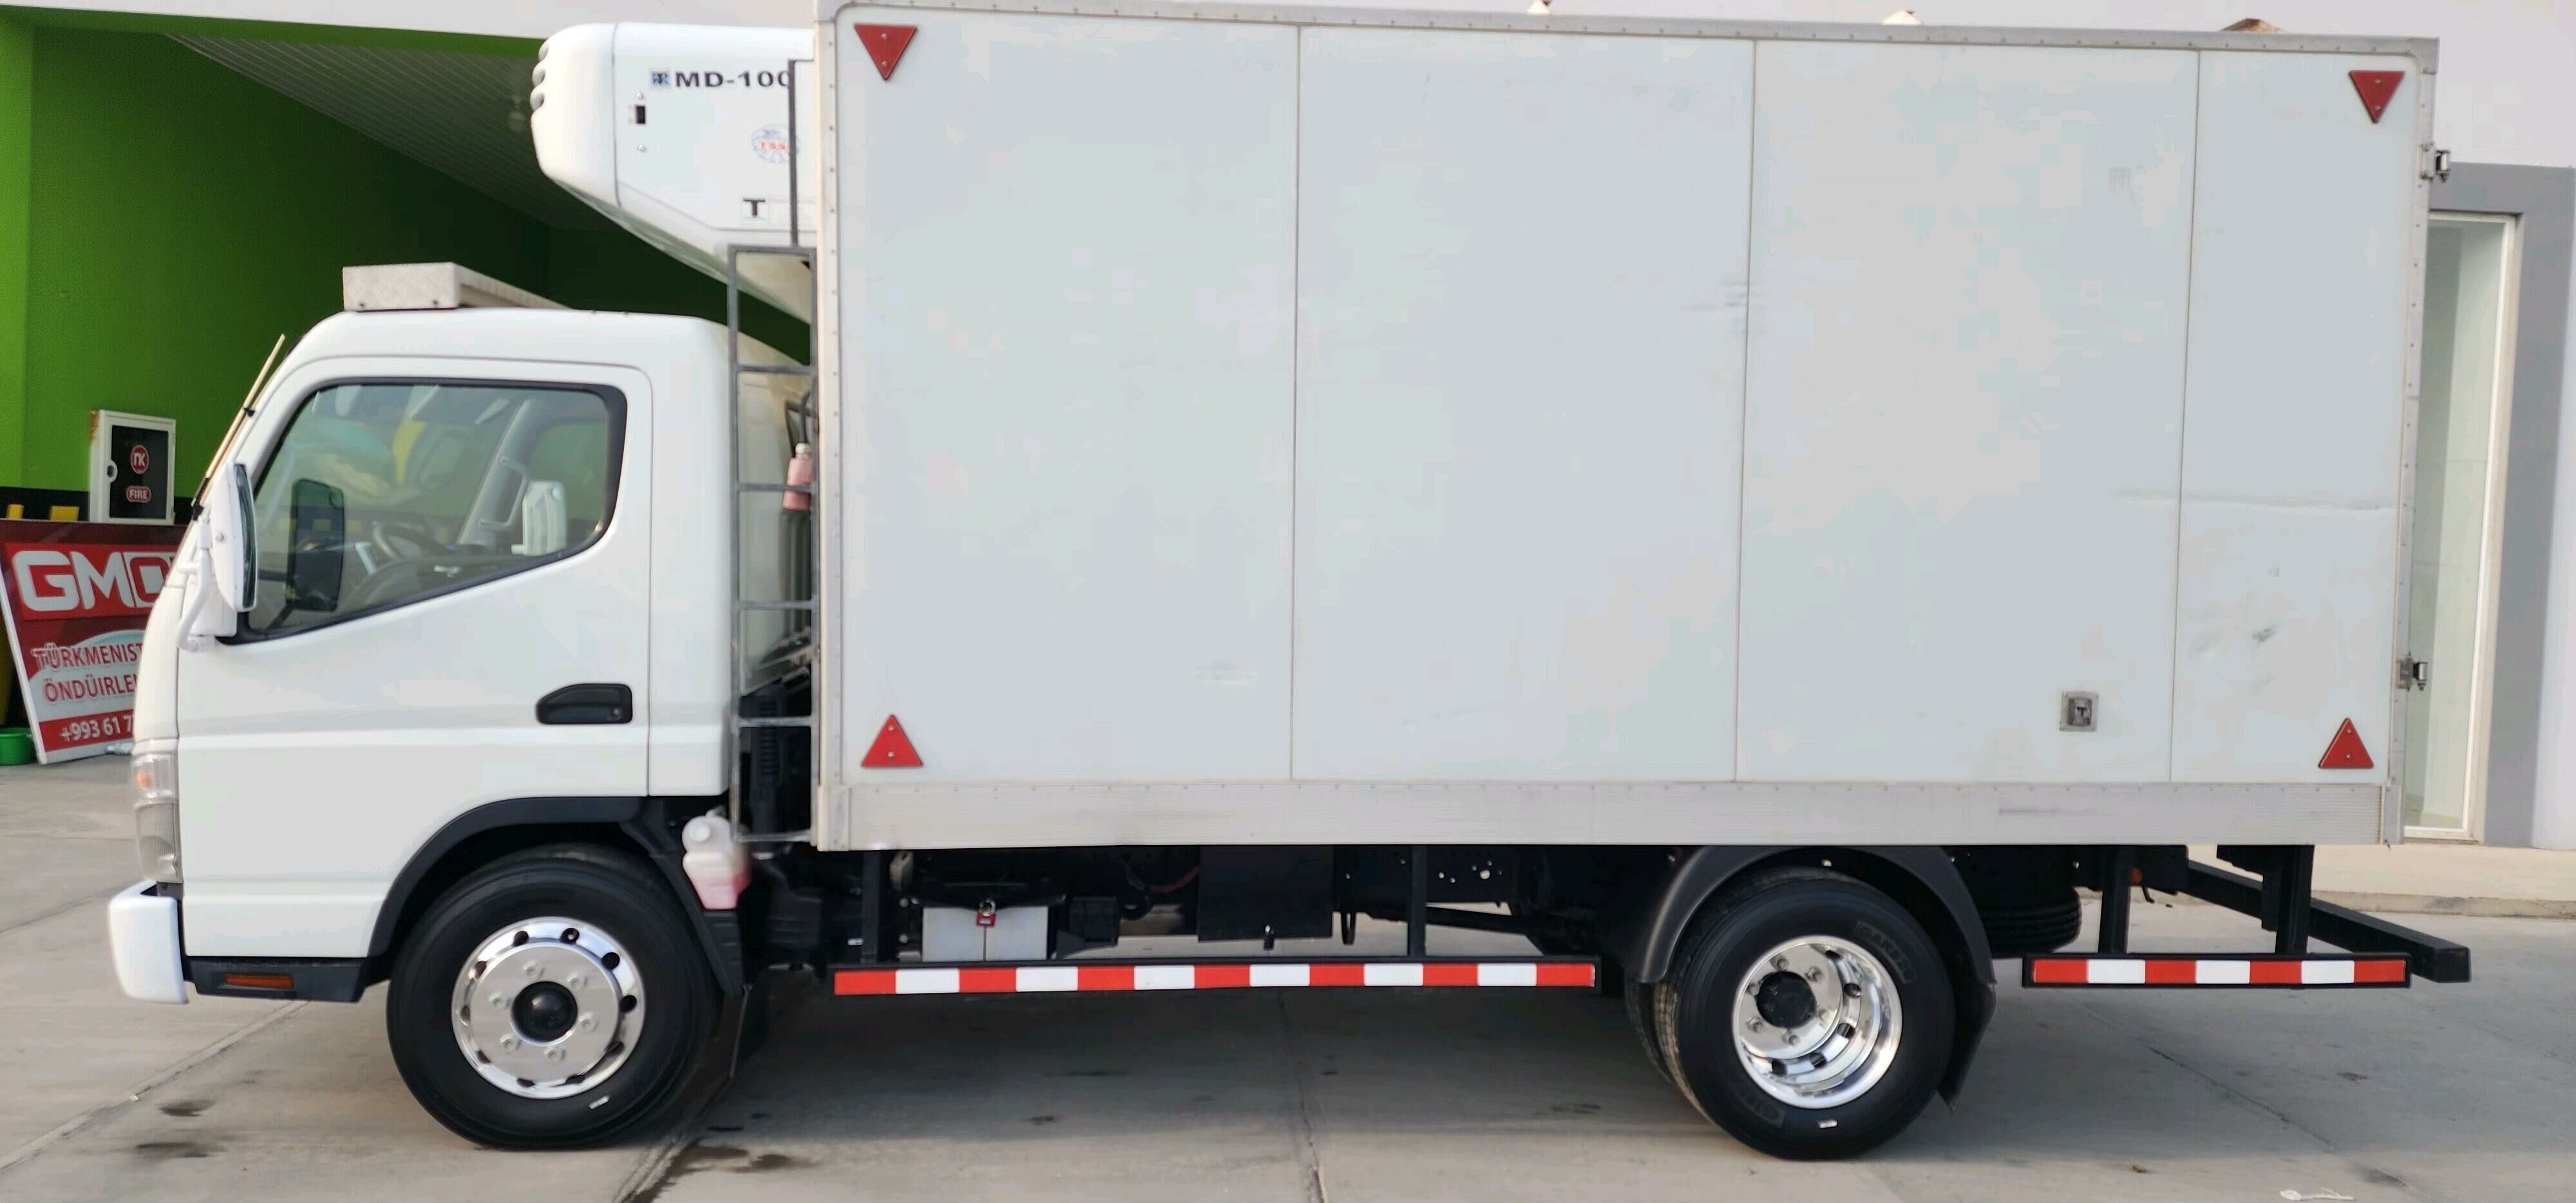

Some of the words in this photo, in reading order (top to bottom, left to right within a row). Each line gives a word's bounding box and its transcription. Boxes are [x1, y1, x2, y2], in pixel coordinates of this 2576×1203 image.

[129, 489, 147, 500] FIRE
[12, 550, 173, 612] GMO
[44, 673, 138, 703] ÖNDÜIRLE
[60, 719, 100, 741] +993
[103, 716, 121, 735] 61
